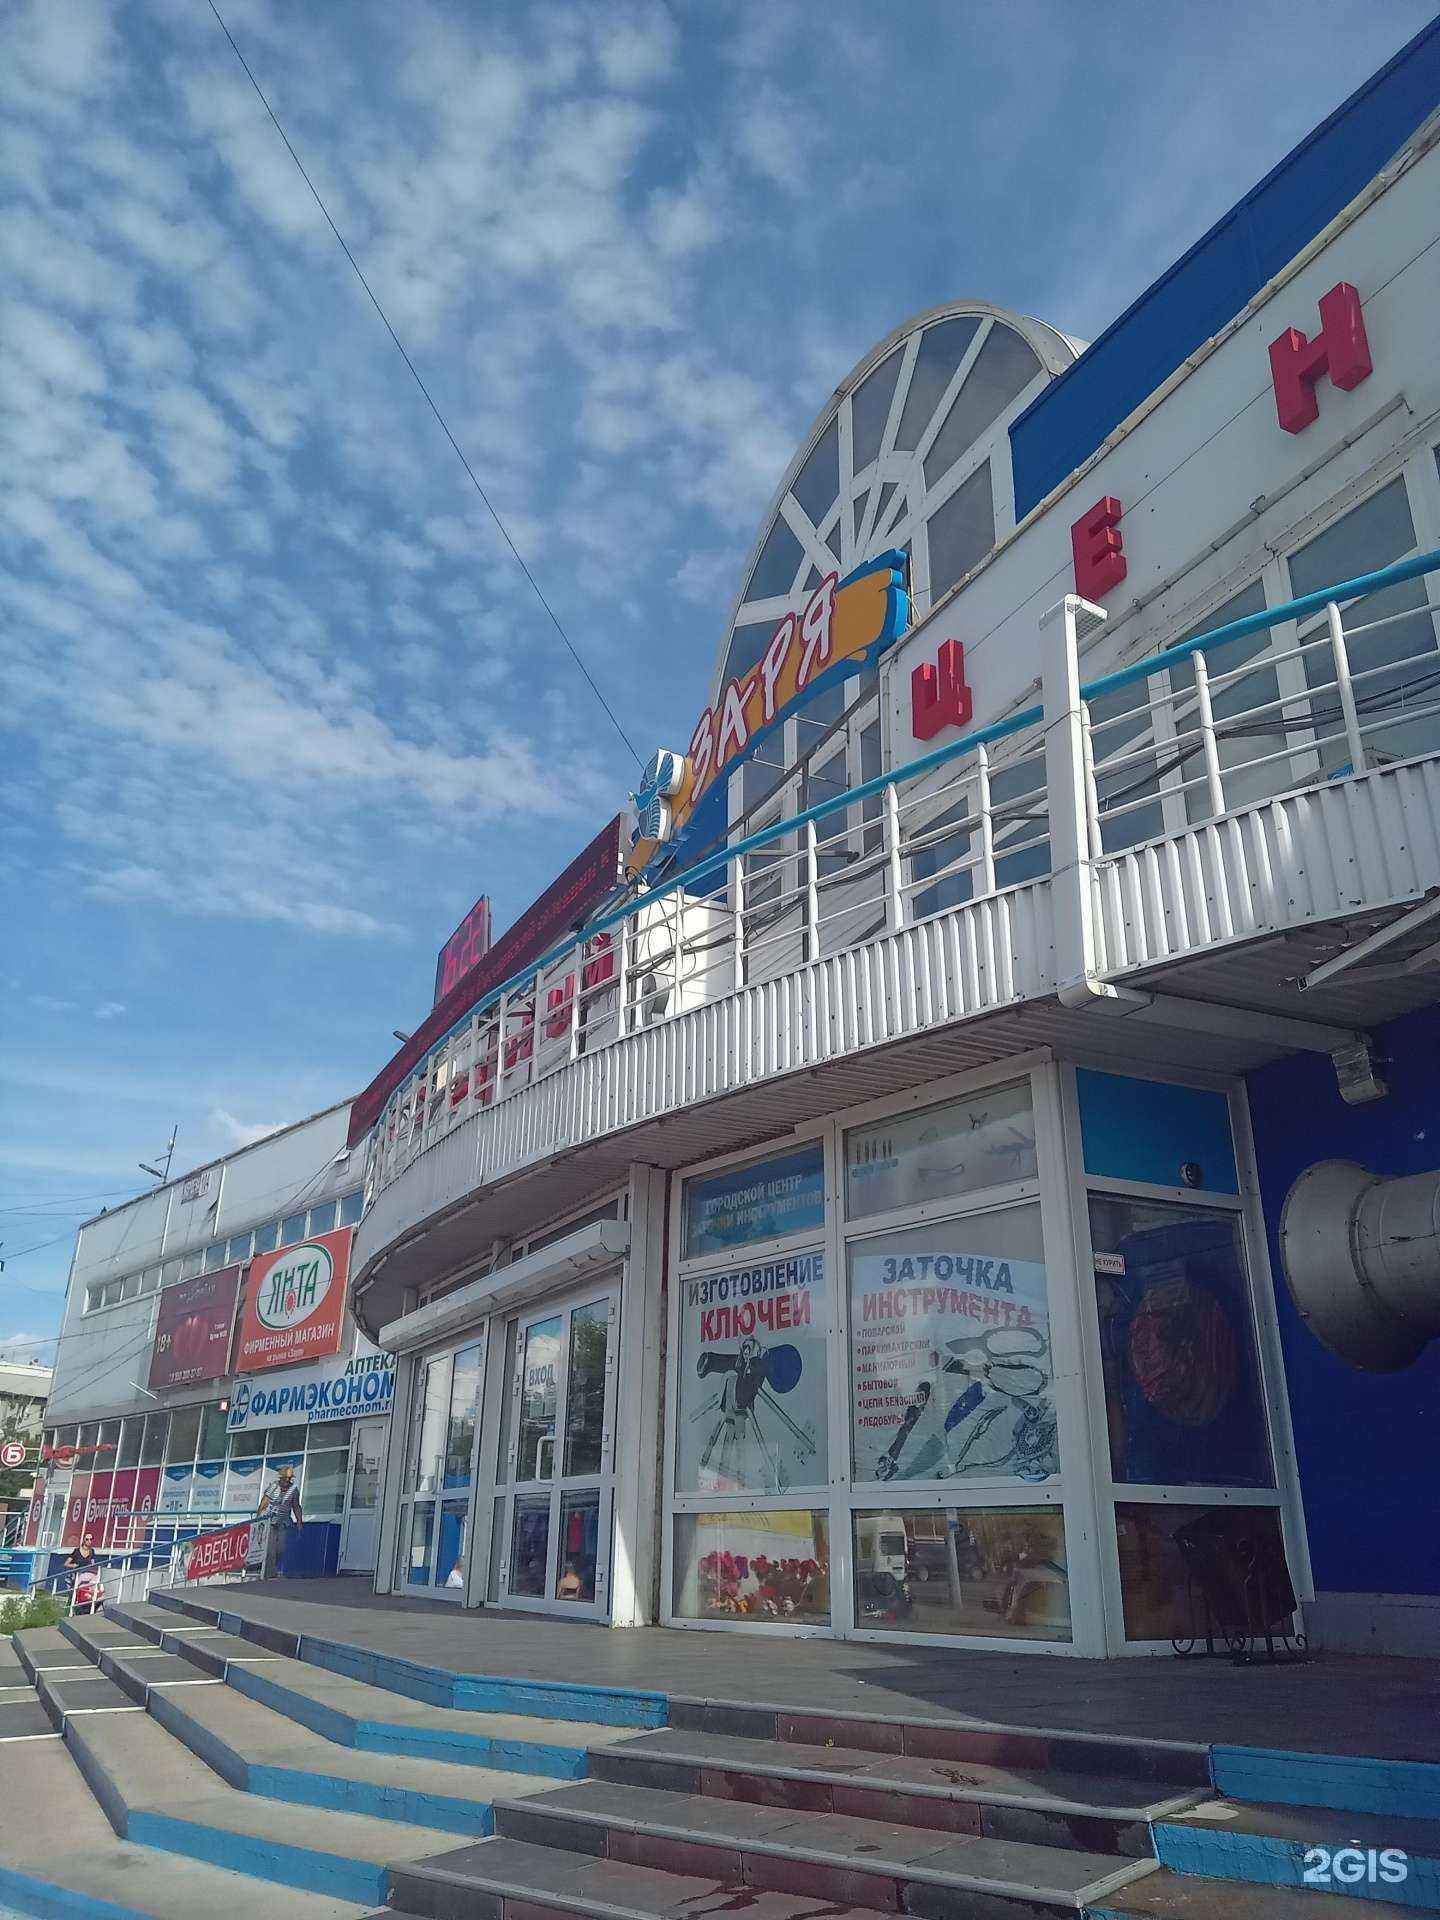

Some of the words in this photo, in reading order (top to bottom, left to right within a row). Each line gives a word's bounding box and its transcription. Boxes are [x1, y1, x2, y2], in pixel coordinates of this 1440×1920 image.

[690, 571, 839, 808] ЗАРЯ
[768, 1175, 802, 1197] ЦЕНТР
[267, 1260, 320, 1315] ЯНТА
[688, 1255, 823, 1306] ИЗГОТОВЛЕНИЕ
[883, 1255, 1014, 1294] ЗАТОЧКА
[700, 1284, 811, 1343] КЛЮЧЕЙ
[863, 1287, 1033, 1328] ИНСТРУМЕНТА
[157, 1334, 171, 1353] 18+
[244, 1329, 293, 1355] ФИРМЕННЫЙ
[295, 1322, 334, 1344] МАГАЗИН
[529, 1364, 557, 1387] ВХОД
[308, 1401, 392, 1423] pharmeconom.r
[189, 1533, 249, 1569] FABERLIC
